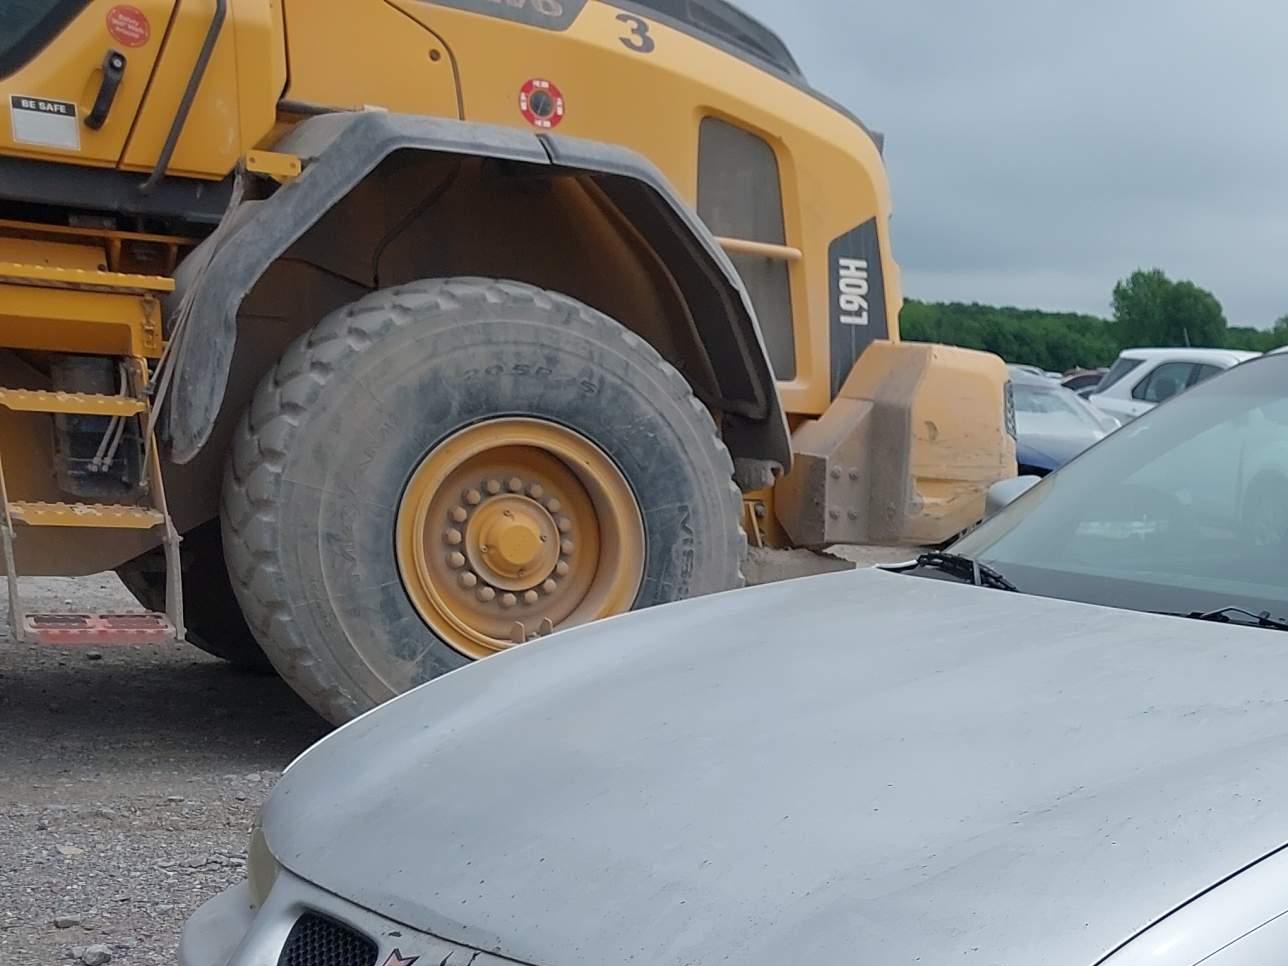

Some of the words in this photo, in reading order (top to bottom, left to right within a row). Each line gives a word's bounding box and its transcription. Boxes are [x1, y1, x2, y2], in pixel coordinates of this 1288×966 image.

[614, 13, 656, 54] 3
[20, 98, 37, 109] BE
[38, 101, 67, 113] SAFE
[838, 258, 869, 326] L90H
